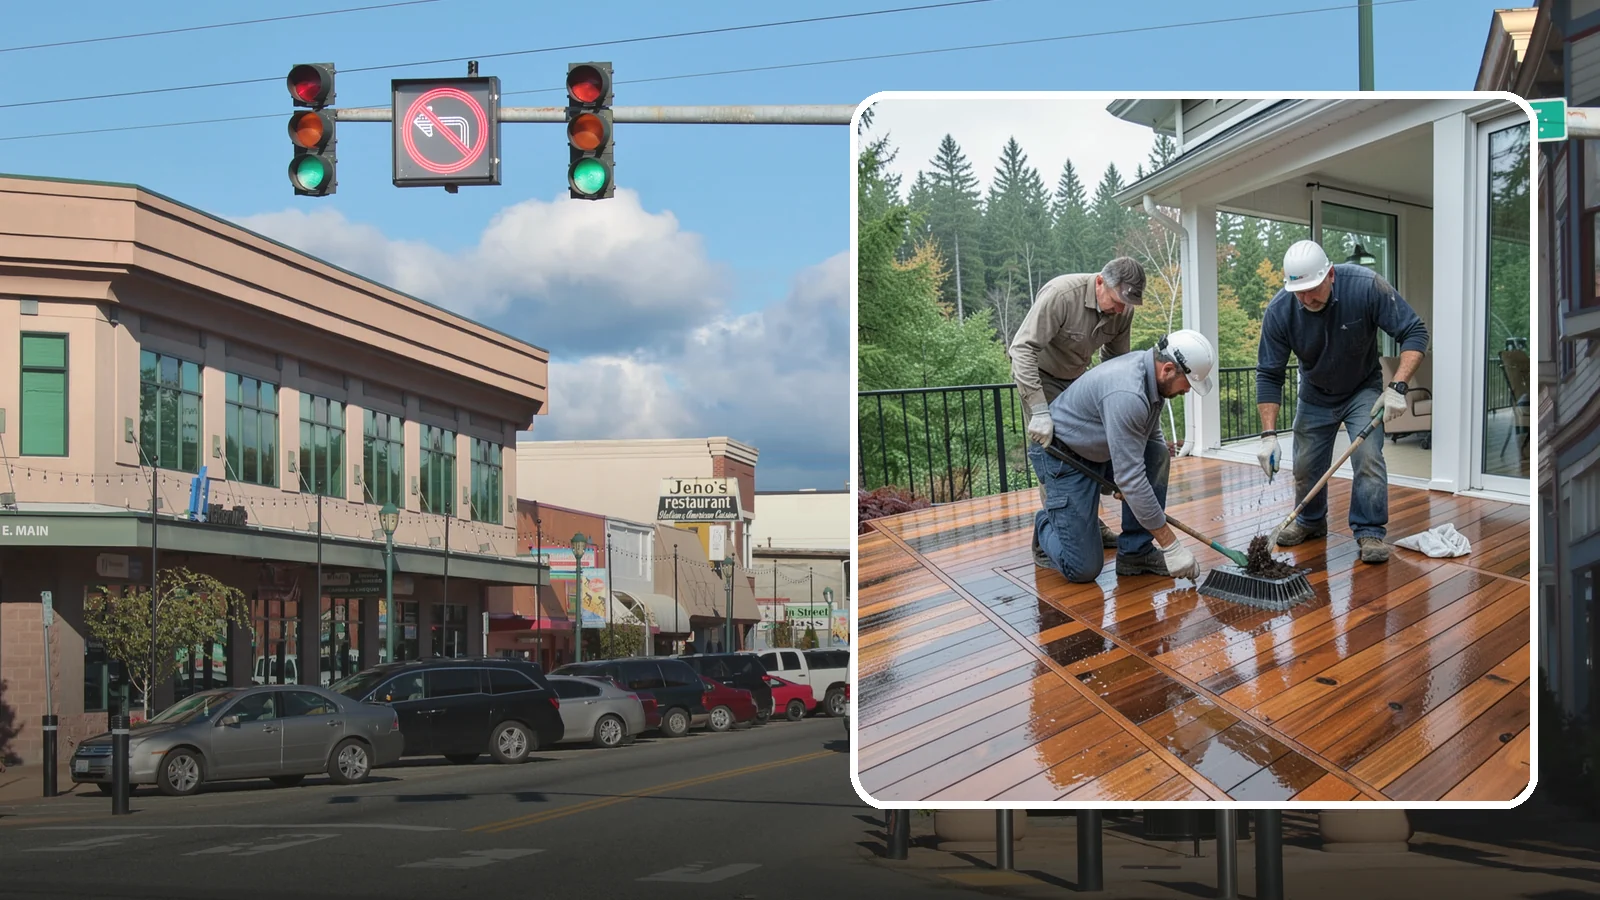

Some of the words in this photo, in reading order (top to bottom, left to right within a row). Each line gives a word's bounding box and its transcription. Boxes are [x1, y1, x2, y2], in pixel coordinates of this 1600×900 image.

[670, 480, 727, 494] Jeno's
[665, 497, 731, 508] restaurant
[658, 511, 682, 519] Italian
[686, 510, 714, 519] American
[715, 509, 737, 519] Cuisine
[2, 525, 13, 536] E.
[15, 525, 49, 537] MAIN
[797, 607, 828, 617] Street
